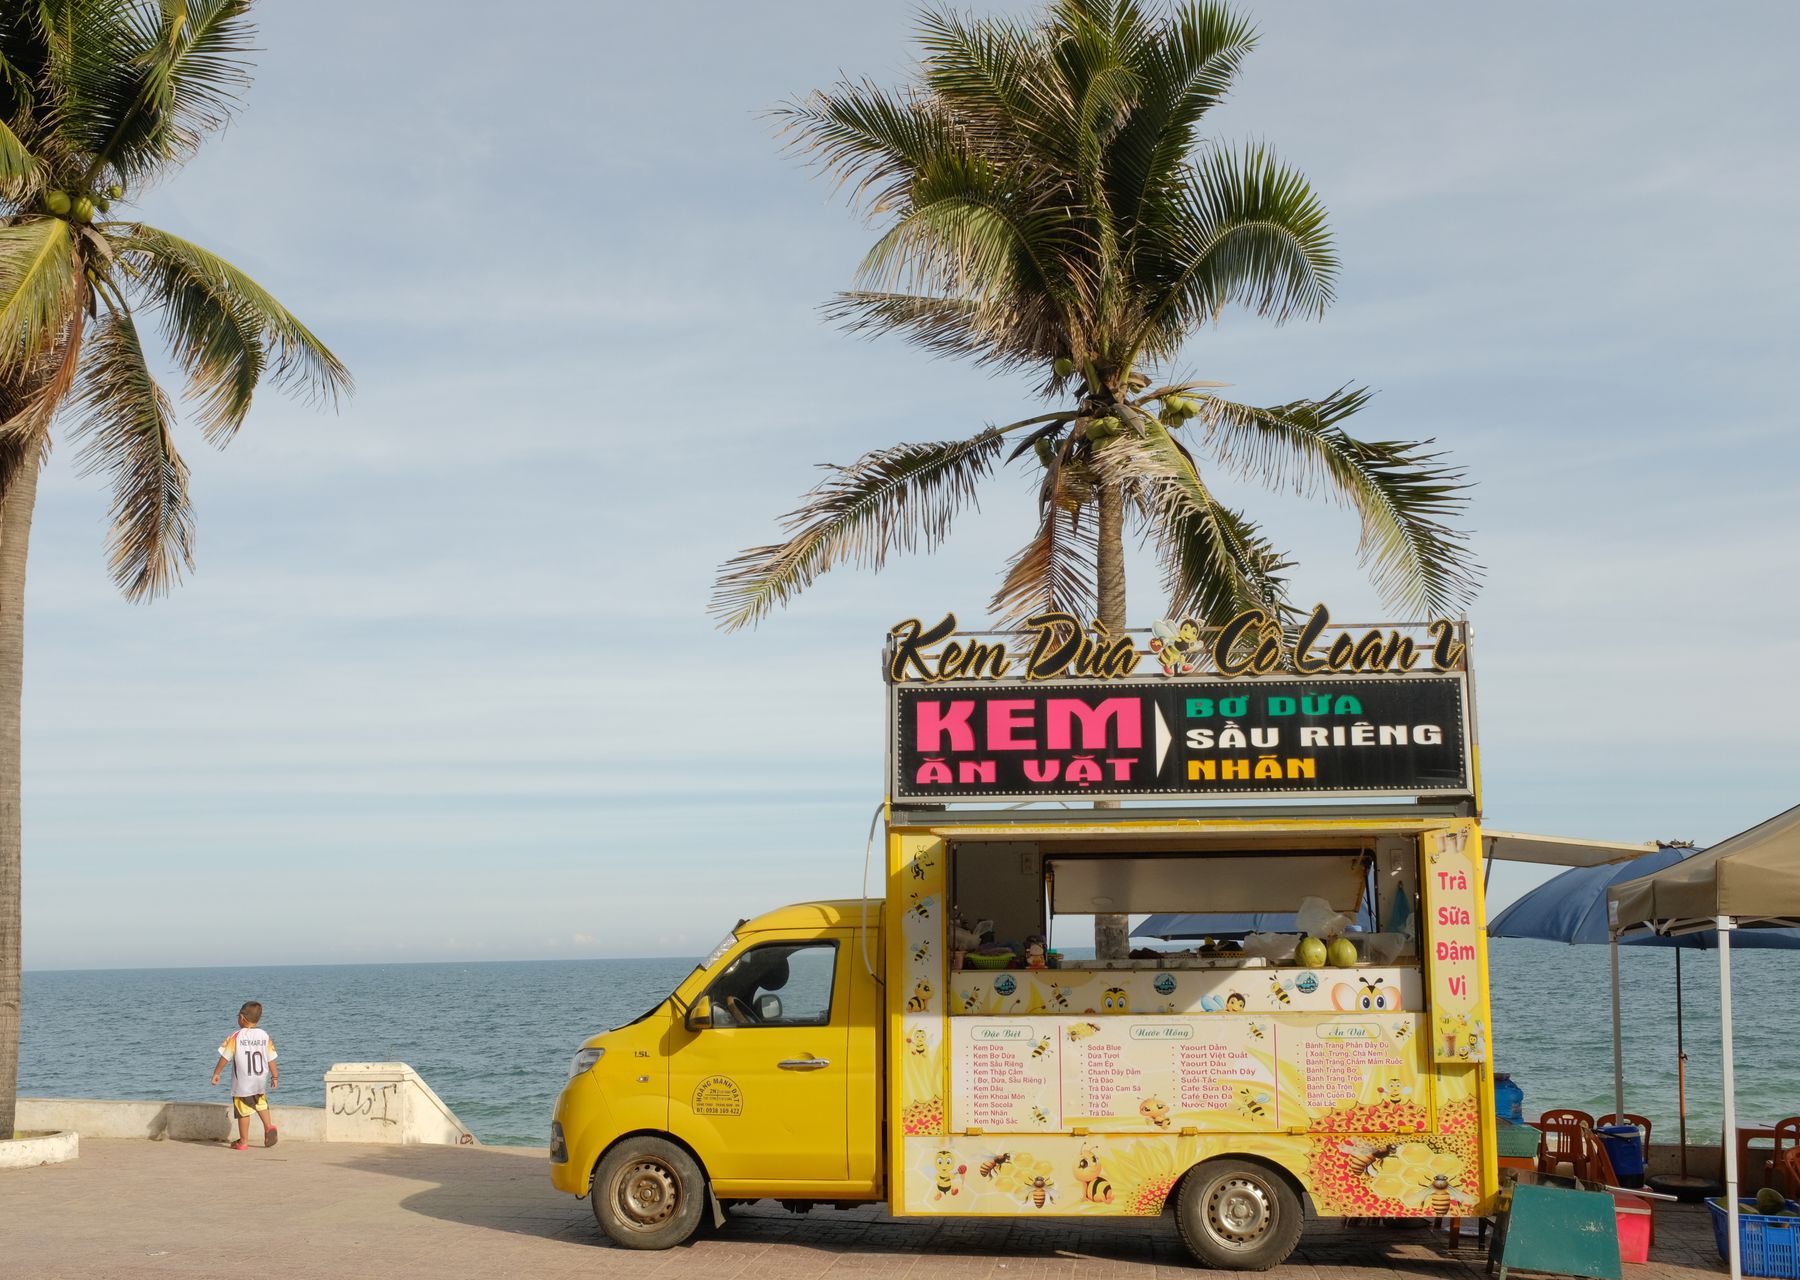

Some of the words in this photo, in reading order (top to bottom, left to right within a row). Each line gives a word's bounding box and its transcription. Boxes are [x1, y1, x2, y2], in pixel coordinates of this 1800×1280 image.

[891, 612, 1012, 682] Kem
[1024, 612, 1142, 680] Dừa
[1213, 608, 1284, 677] Cô
[1294, 602, 1420, 674] Loan
[1185, 695, 1249, 718] BƠ
[1268, 692, 1362, 716] DỪA
[916, 697, 1142, 752] KEM
[1186, 721, 1279, 749] SẦU
[1300, 721, 1442, 746] RIÊNG
[915, 757, 997, 784] ĂN
[1022, 755, 1138, 786] VẶT
[1187, 754, 1316, 780] NHÃN
[1437, 870, 1467, 890] Trà
[1438, 906, 1470, 926] Sữa
[1436, 940, 1475, 965] Đậm
[1448, 975, 1467, 1000] Vị
[245, 1051, 264, 1076] 10
